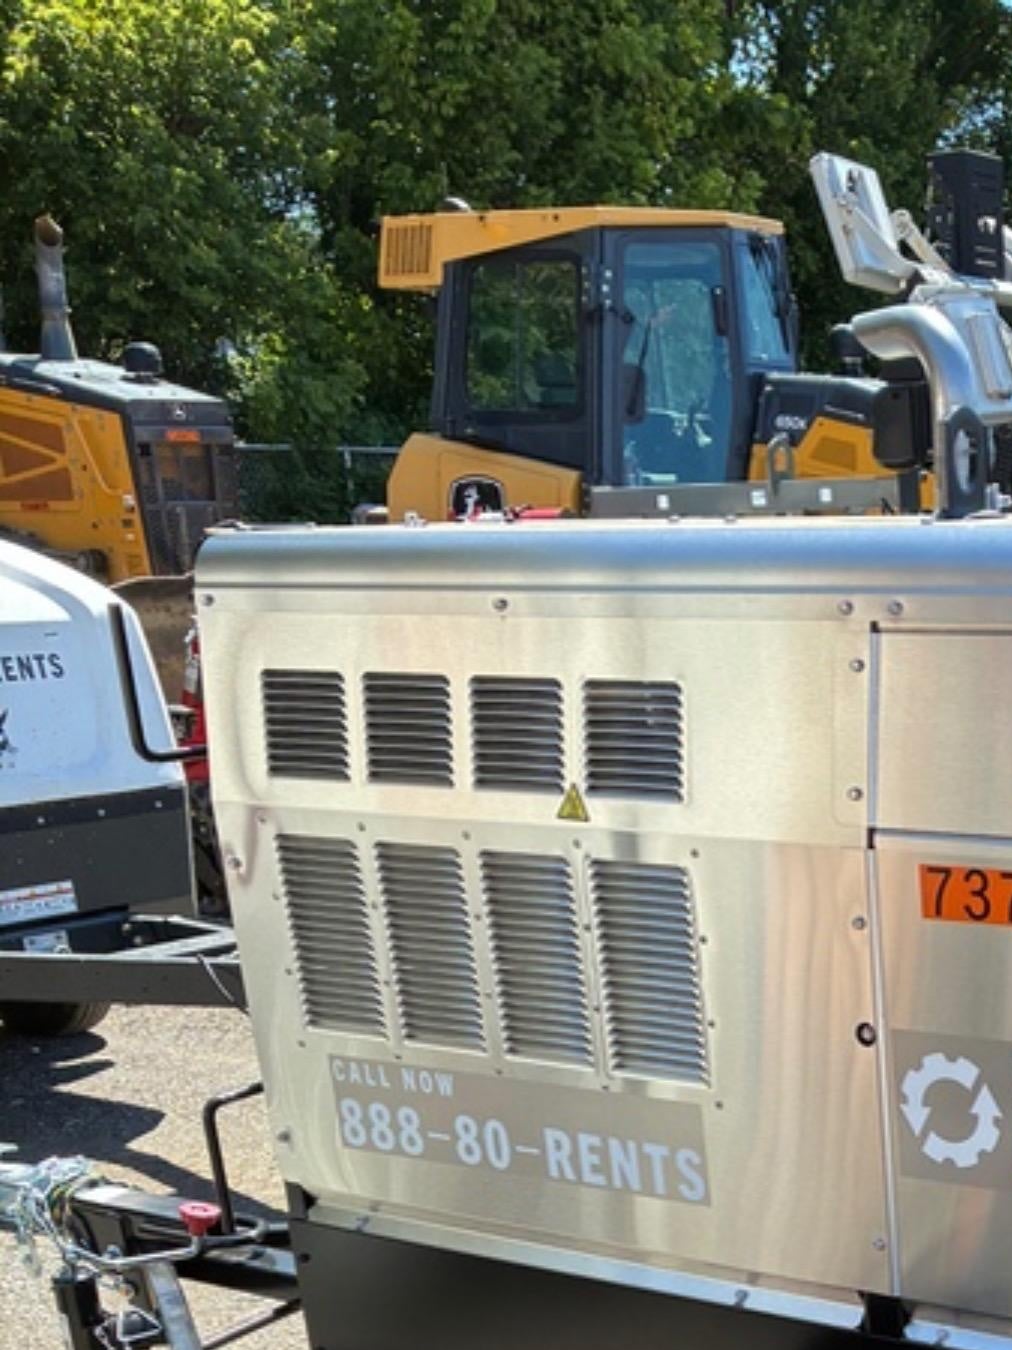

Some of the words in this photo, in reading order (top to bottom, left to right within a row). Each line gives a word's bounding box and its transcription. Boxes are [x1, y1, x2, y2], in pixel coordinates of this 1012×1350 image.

[0, 653, 64, 682] ENTS
[331, 1058, 391, 1089] CALL
[402, 1066, 455, 1097] NOW
[339, 1097, 706, 1201] 888-80-RENTS
